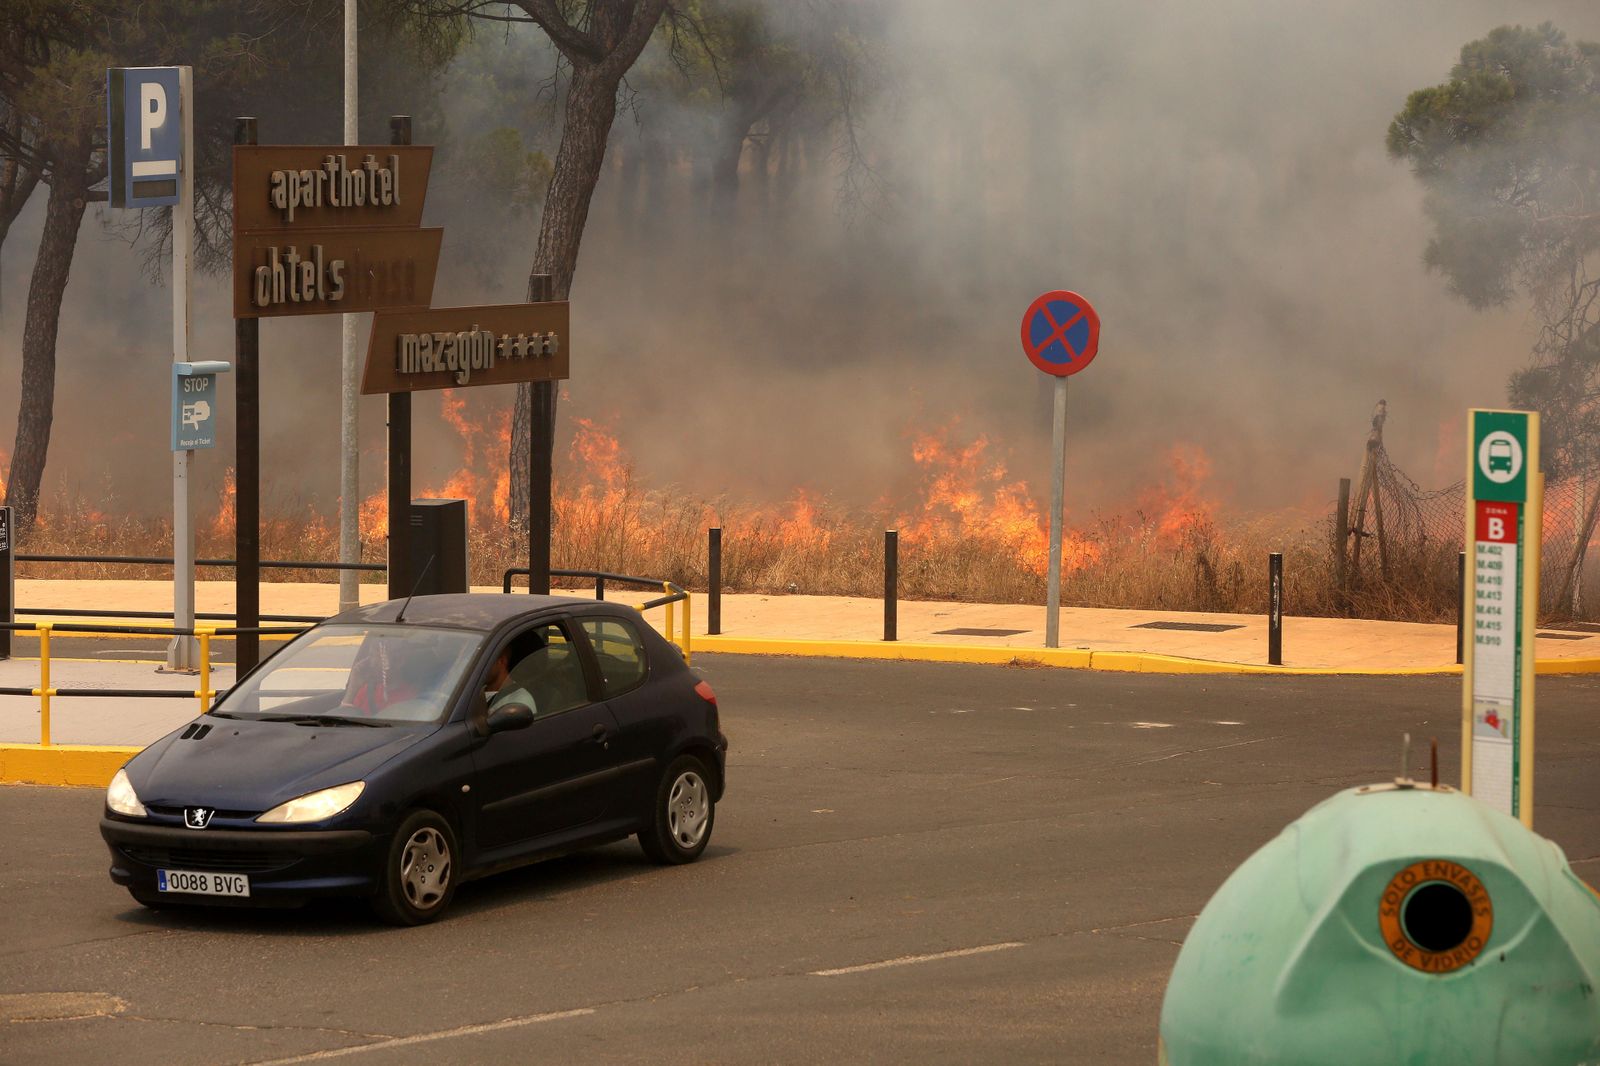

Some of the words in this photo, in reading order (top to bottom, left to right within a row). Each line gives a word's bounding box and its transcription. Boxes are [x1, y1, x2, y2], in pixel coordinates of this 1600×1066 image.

[141, 82, 167, 150] P
[271, 154, 401, 223] aparthotel
[255, 244, 345, 308] ohtels
[399, 324, 495, 385] mazagón
[184, 378, 209, 392] STOP
[1485, 507, 1508, 515] ZONA
[1488, 517, 1505, 540] B
[170, 873, 208, 891] 0088
[213, 876, 244, 894] BVG
[1382, 871, 1416, 917] SOLO
[1422, 863, 1489, 917] ENVASES
[1392, 939, 1415, 960] DE
[1420, 936, 1482, 970] VIDRIO
